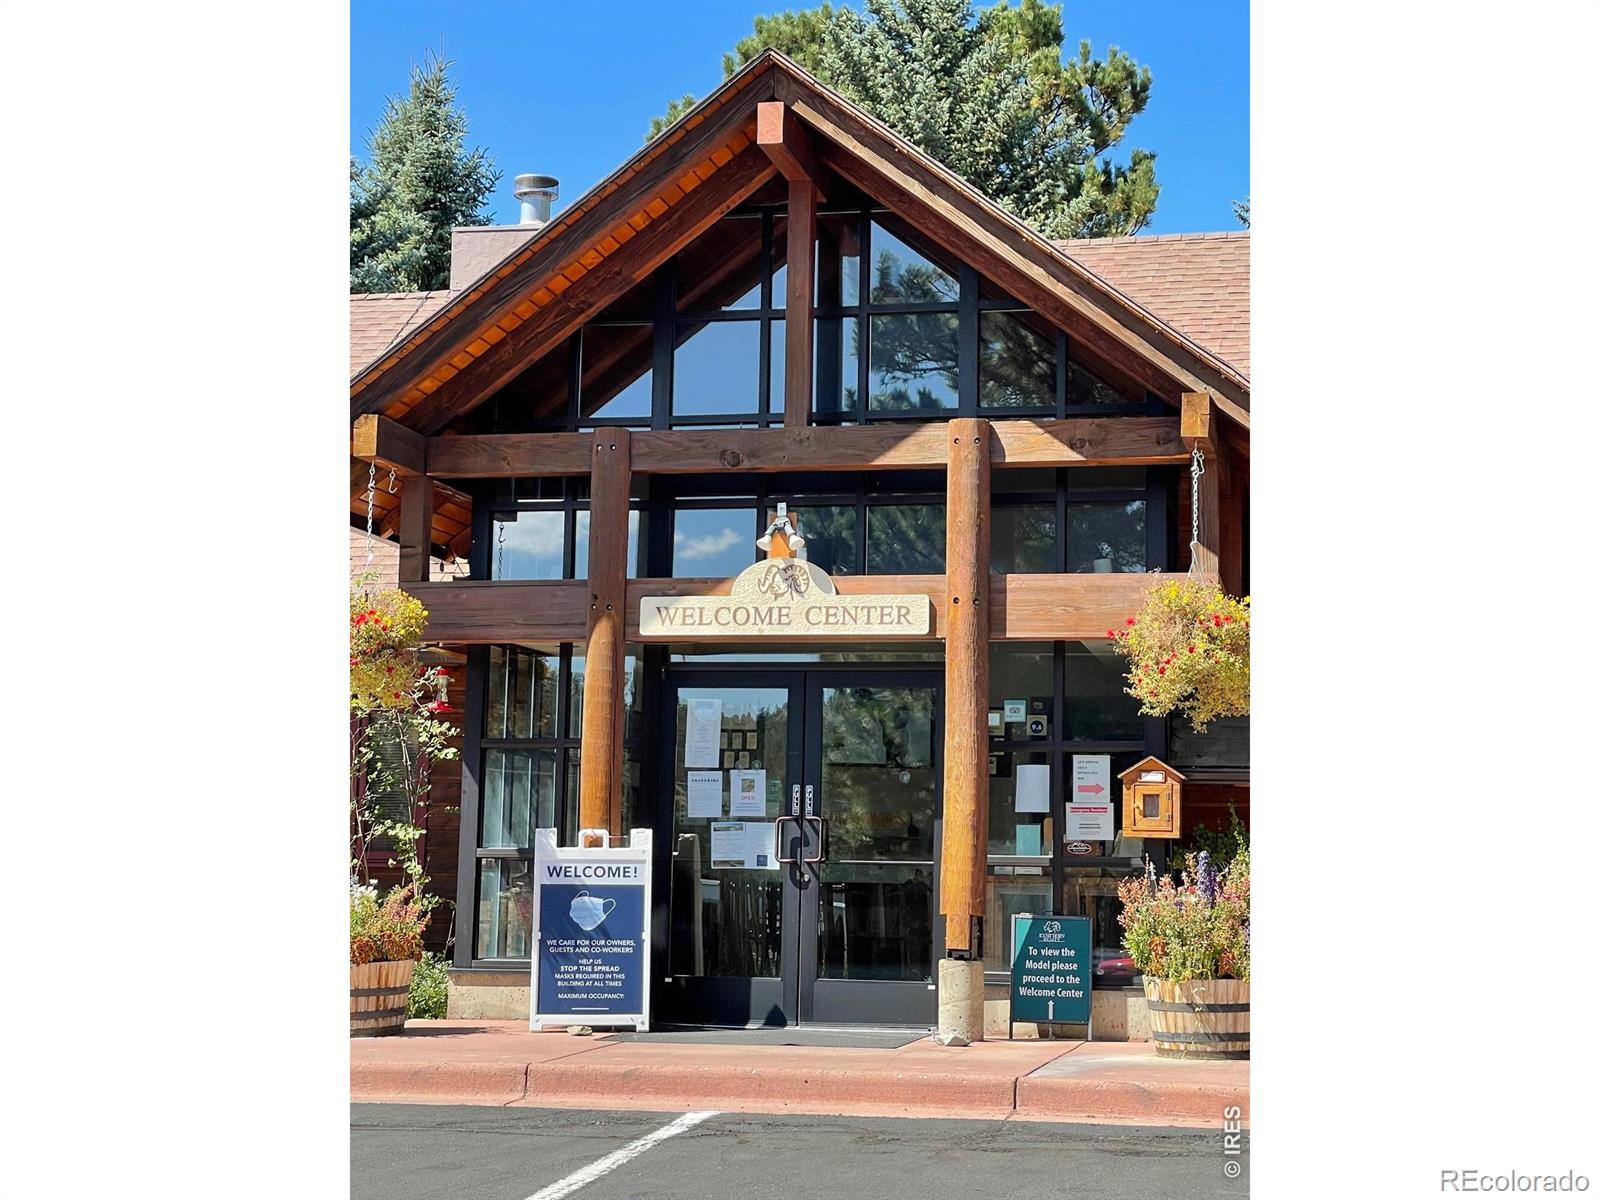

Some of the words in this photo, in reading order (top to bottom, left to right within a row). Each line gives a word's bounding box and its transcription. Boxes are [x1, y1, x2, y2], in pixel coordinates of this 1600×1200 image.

[655, 605, 791, 626] WELCOME
[804, 604, 914, 625] CENTER
[547, 865, 638, 878] WELCOME!
[606, 939, 636, 947] OWNERS,
[1028, 946, 1038, 956] To
[1040, 946, 1059, 957] view
[1061, 947, 1076, 957] the
[1025, 959, 1051, 970] Model
[1051, 960, 1078, 972] please
[1022, 974, 1055, 984] proceed
[1056, 975, 1065, 984] to
[1066, 974, 1081, 984] the
[1019, 986, 1056, 997] Welcome
[1056, 987, 1084, 998] Center
